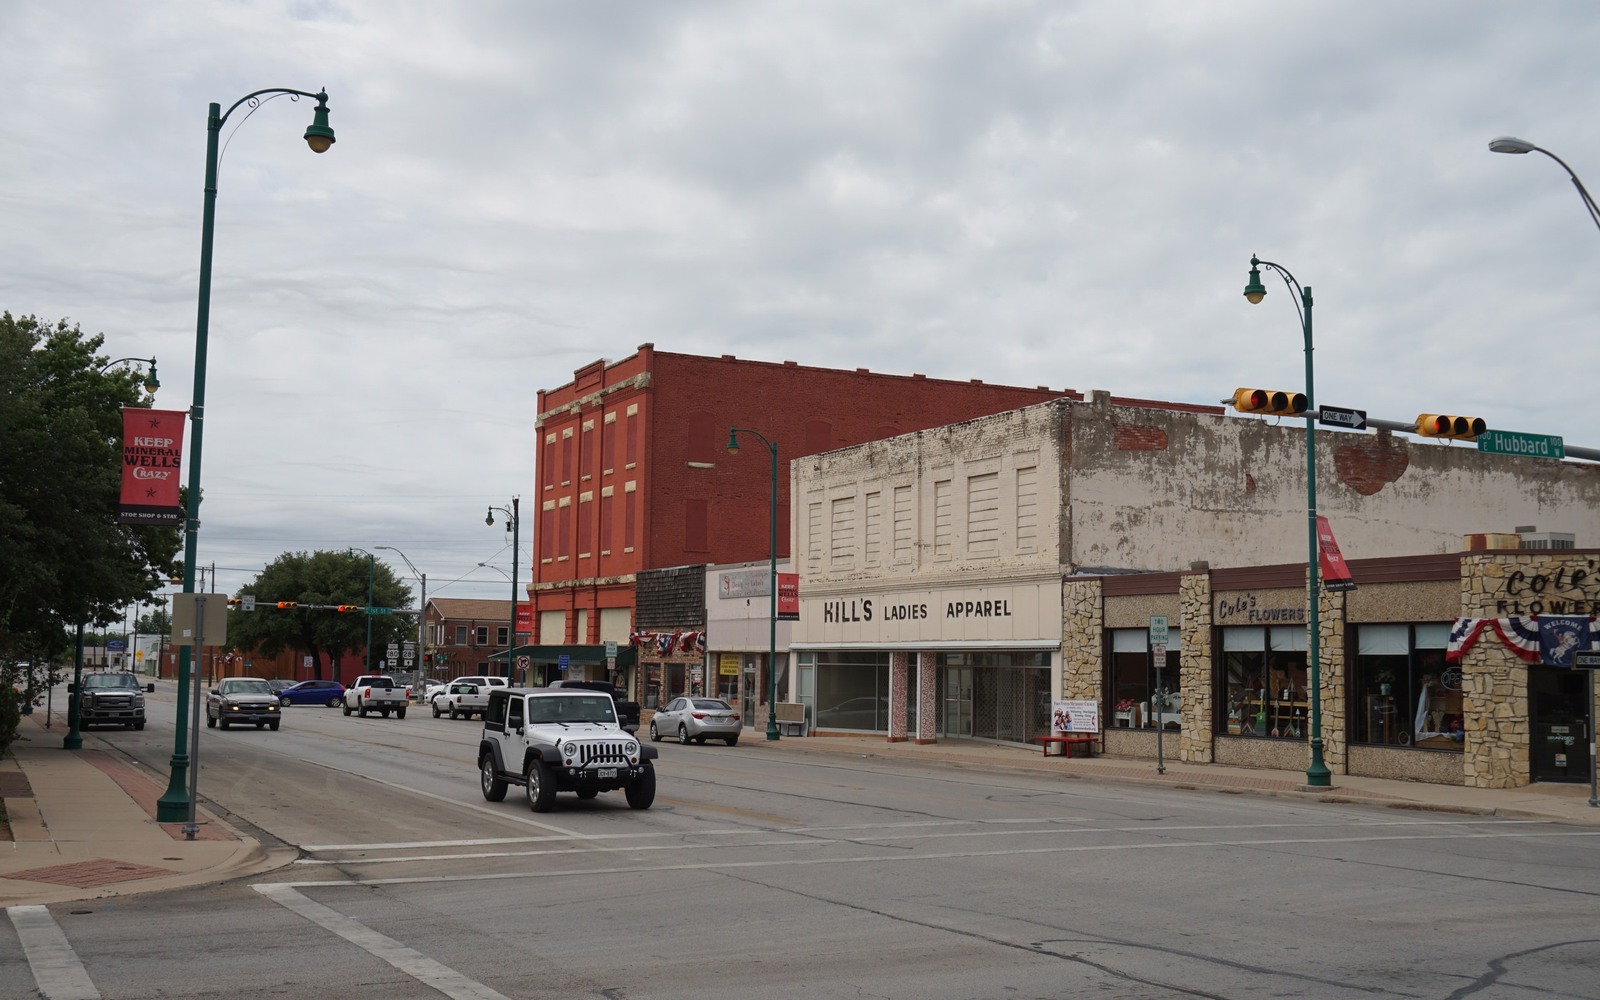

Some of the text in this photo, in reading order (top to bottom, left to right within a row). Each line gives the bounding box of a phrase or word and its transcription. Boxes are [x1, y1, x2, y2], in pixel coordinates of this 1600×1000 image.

[1324, 412, 1352, 422] ONE WAY
[134, 436, 173, 447] KEEP
[1483, 442, 1488, 451] E
[1495, 433, 1548, 454] Hubbard
[1551, 437, 1562, 447] 100
[124, 447, 181, 457] MINERAL
[124, 455, 181, 468] WELLS
[824, 598, 1012, 623] HILL'S LADIES APPAREL
[1219, 592, 1256, 618] Cole's
[1249, 608, 1304, 621] FLOWERS
[1543, 619, 1583, 632] WELCOME
[1578, 656, 1588, 664] ONE
[1443, 672, 1462, 685] OPE
